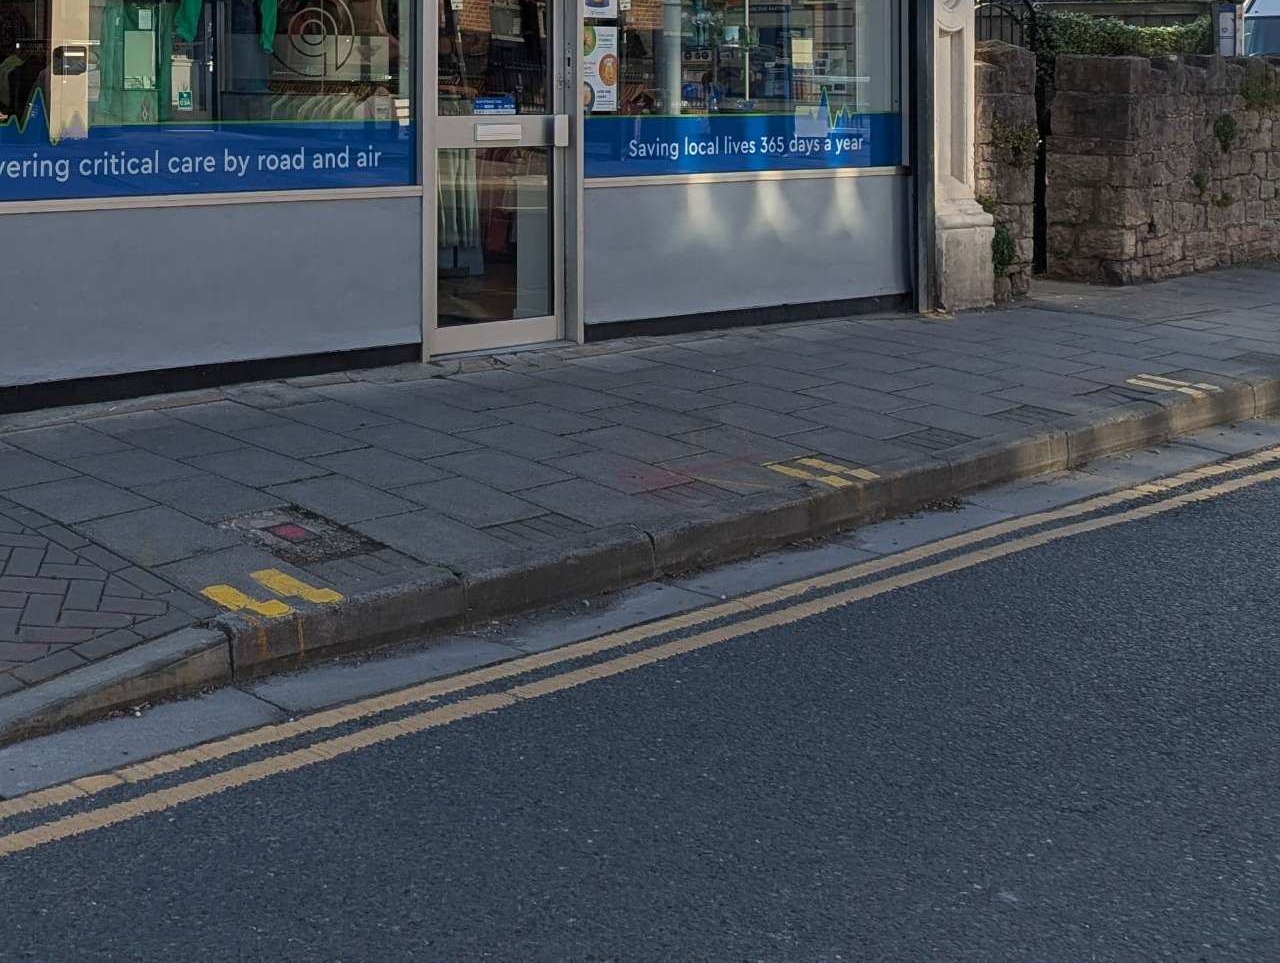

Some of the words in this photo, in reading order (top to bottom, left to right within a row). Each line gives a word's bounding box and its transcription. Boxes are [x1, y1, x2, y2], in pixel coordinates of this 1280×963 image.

[79, 149, 159, 176] critical
[167, 155, 216, 173] care
[224, 148, 250, 177] by
[257, 147, 305, 170] road
[312, 145, 350, 168] and
[356, 145, 382, 167] air
[628, 138, 679, 160] Saving
[684, 136, 719, 155] local
[724, 136, 756, 155] lives
[760, 136, 785, 154] 365
[789, 135, 820, 155] days
[824, 138, 832, 150] a
[835, 136, 864, 155] year
